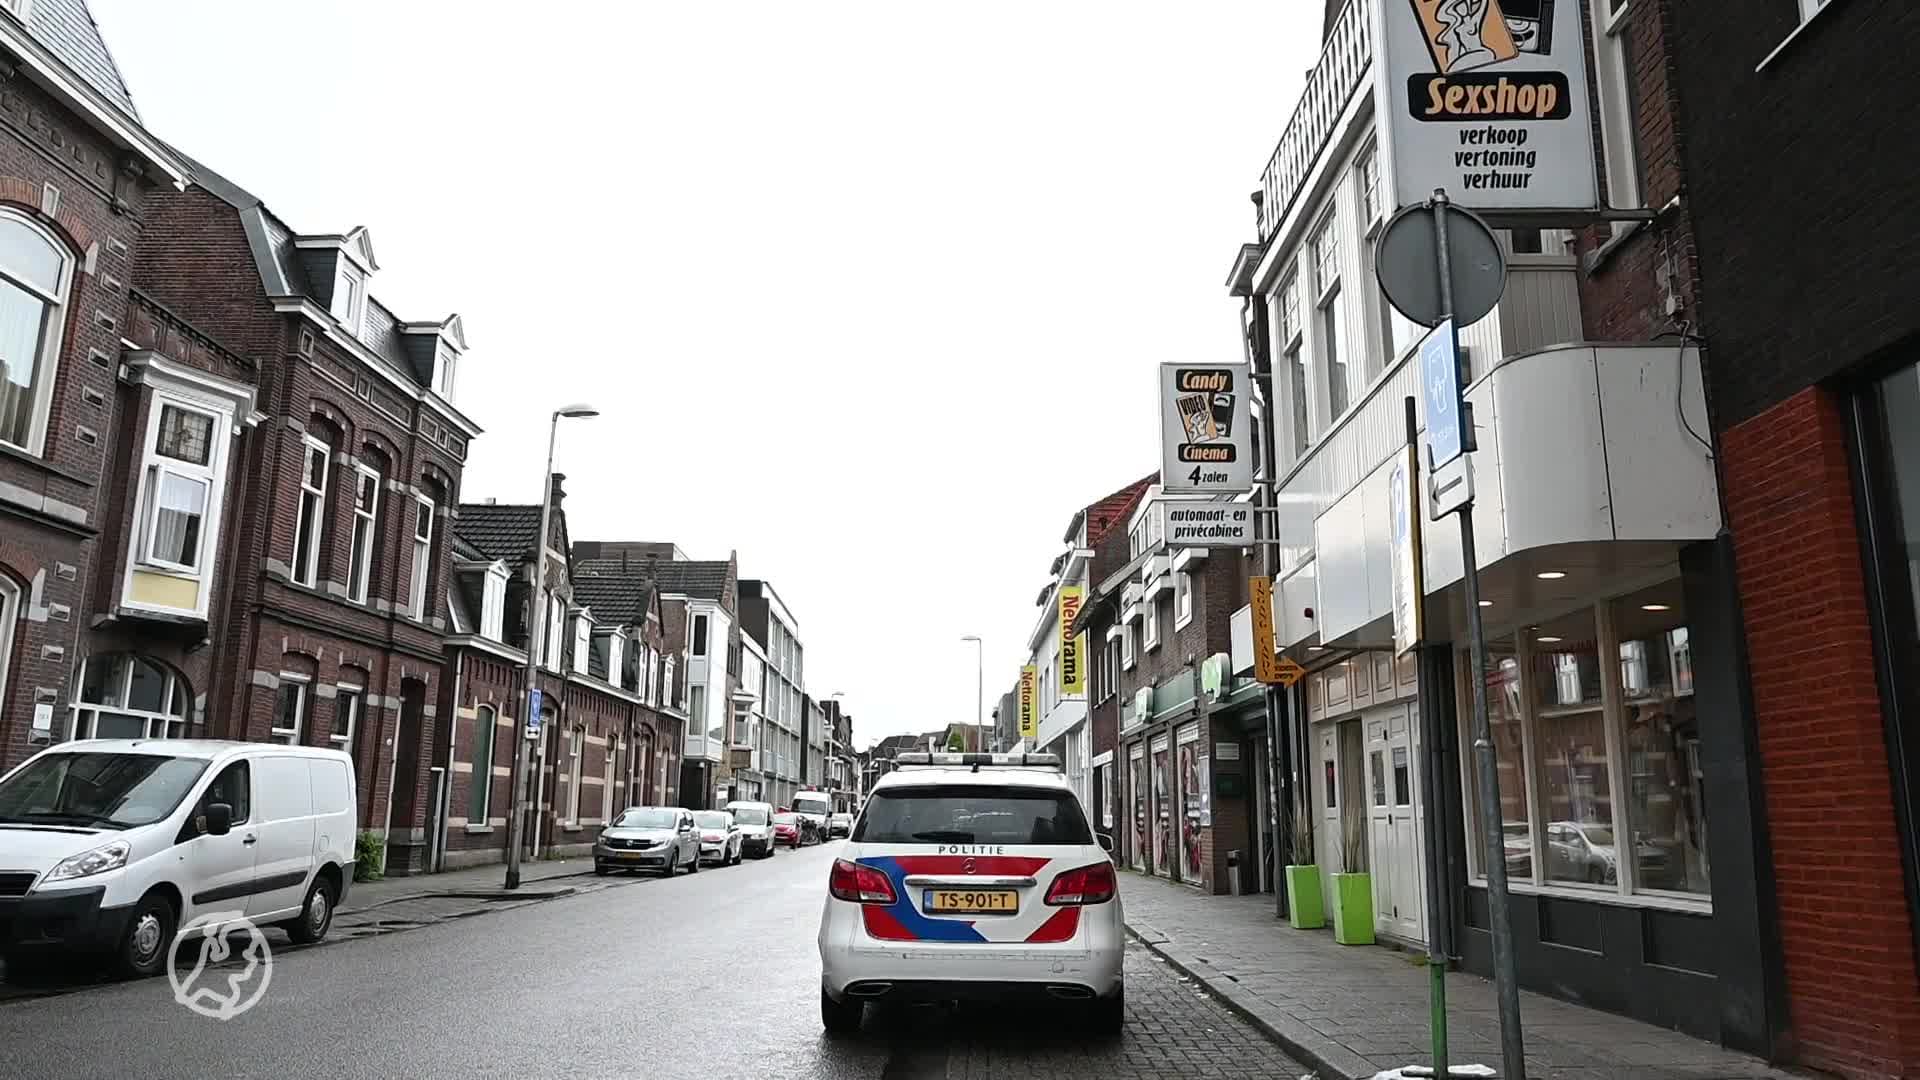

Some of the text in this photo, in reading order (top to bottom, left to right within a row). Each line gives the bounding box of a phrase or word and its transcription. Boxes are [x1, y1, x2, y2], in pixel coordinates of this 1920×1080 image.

[1425, 77, 1557, 118] Sexshop
[1460, 126, 1528, 146] verkoop
[1455, 147, 1537, 168] vertoning
[1463, 170, 1533, 189] verhuur
[1182, 371, 1228, 392] Candy
[1180, 394, 1206, 415] VIDEO
[1183, 446, 1229, 461] Cinema
[1188, 465, 1228, 486] 4 zalen
[1170, 508, 1247, 522] automaat- en
[1174, 523, 1244, 540] privécabines
[1022, 671, 1033, 732] Nettorama
[938, 845, 1005, 855] POLITIE
[939, 893, 1009, 907] TS-901-T
